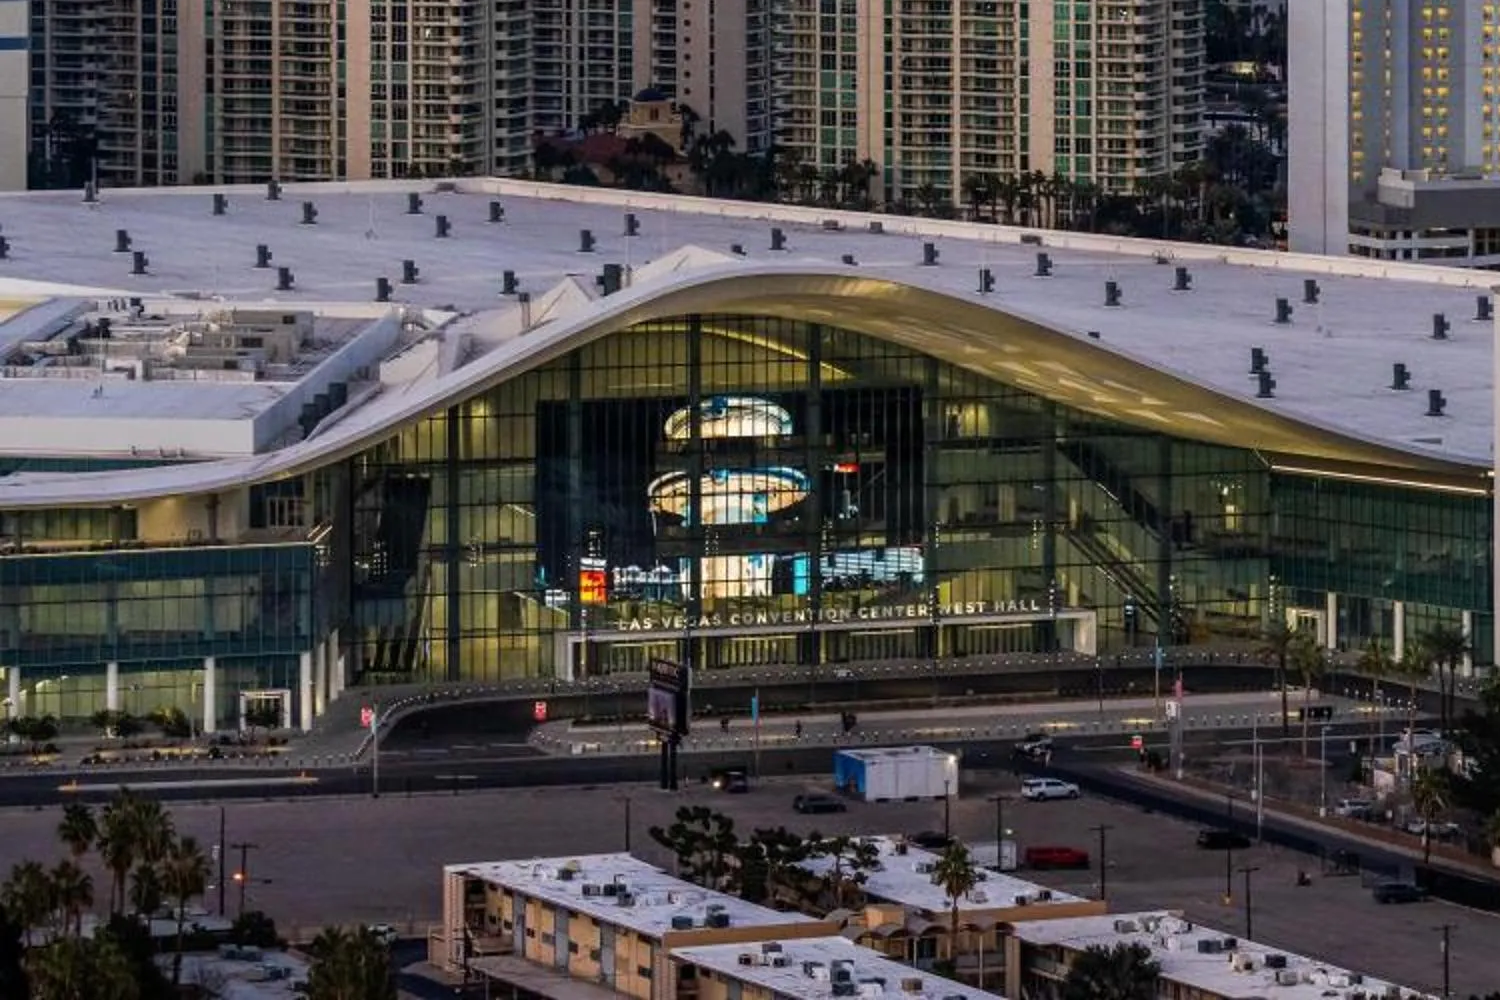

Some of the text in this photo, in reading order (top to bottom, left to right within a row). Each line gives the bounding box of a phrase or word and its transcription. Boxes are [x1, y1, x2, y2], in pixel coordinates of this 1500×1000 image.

[618, 617, 653, 631] LAS
[858, 603, 928, 619] CENTER
[994, 599, 1040, 613] HALL
